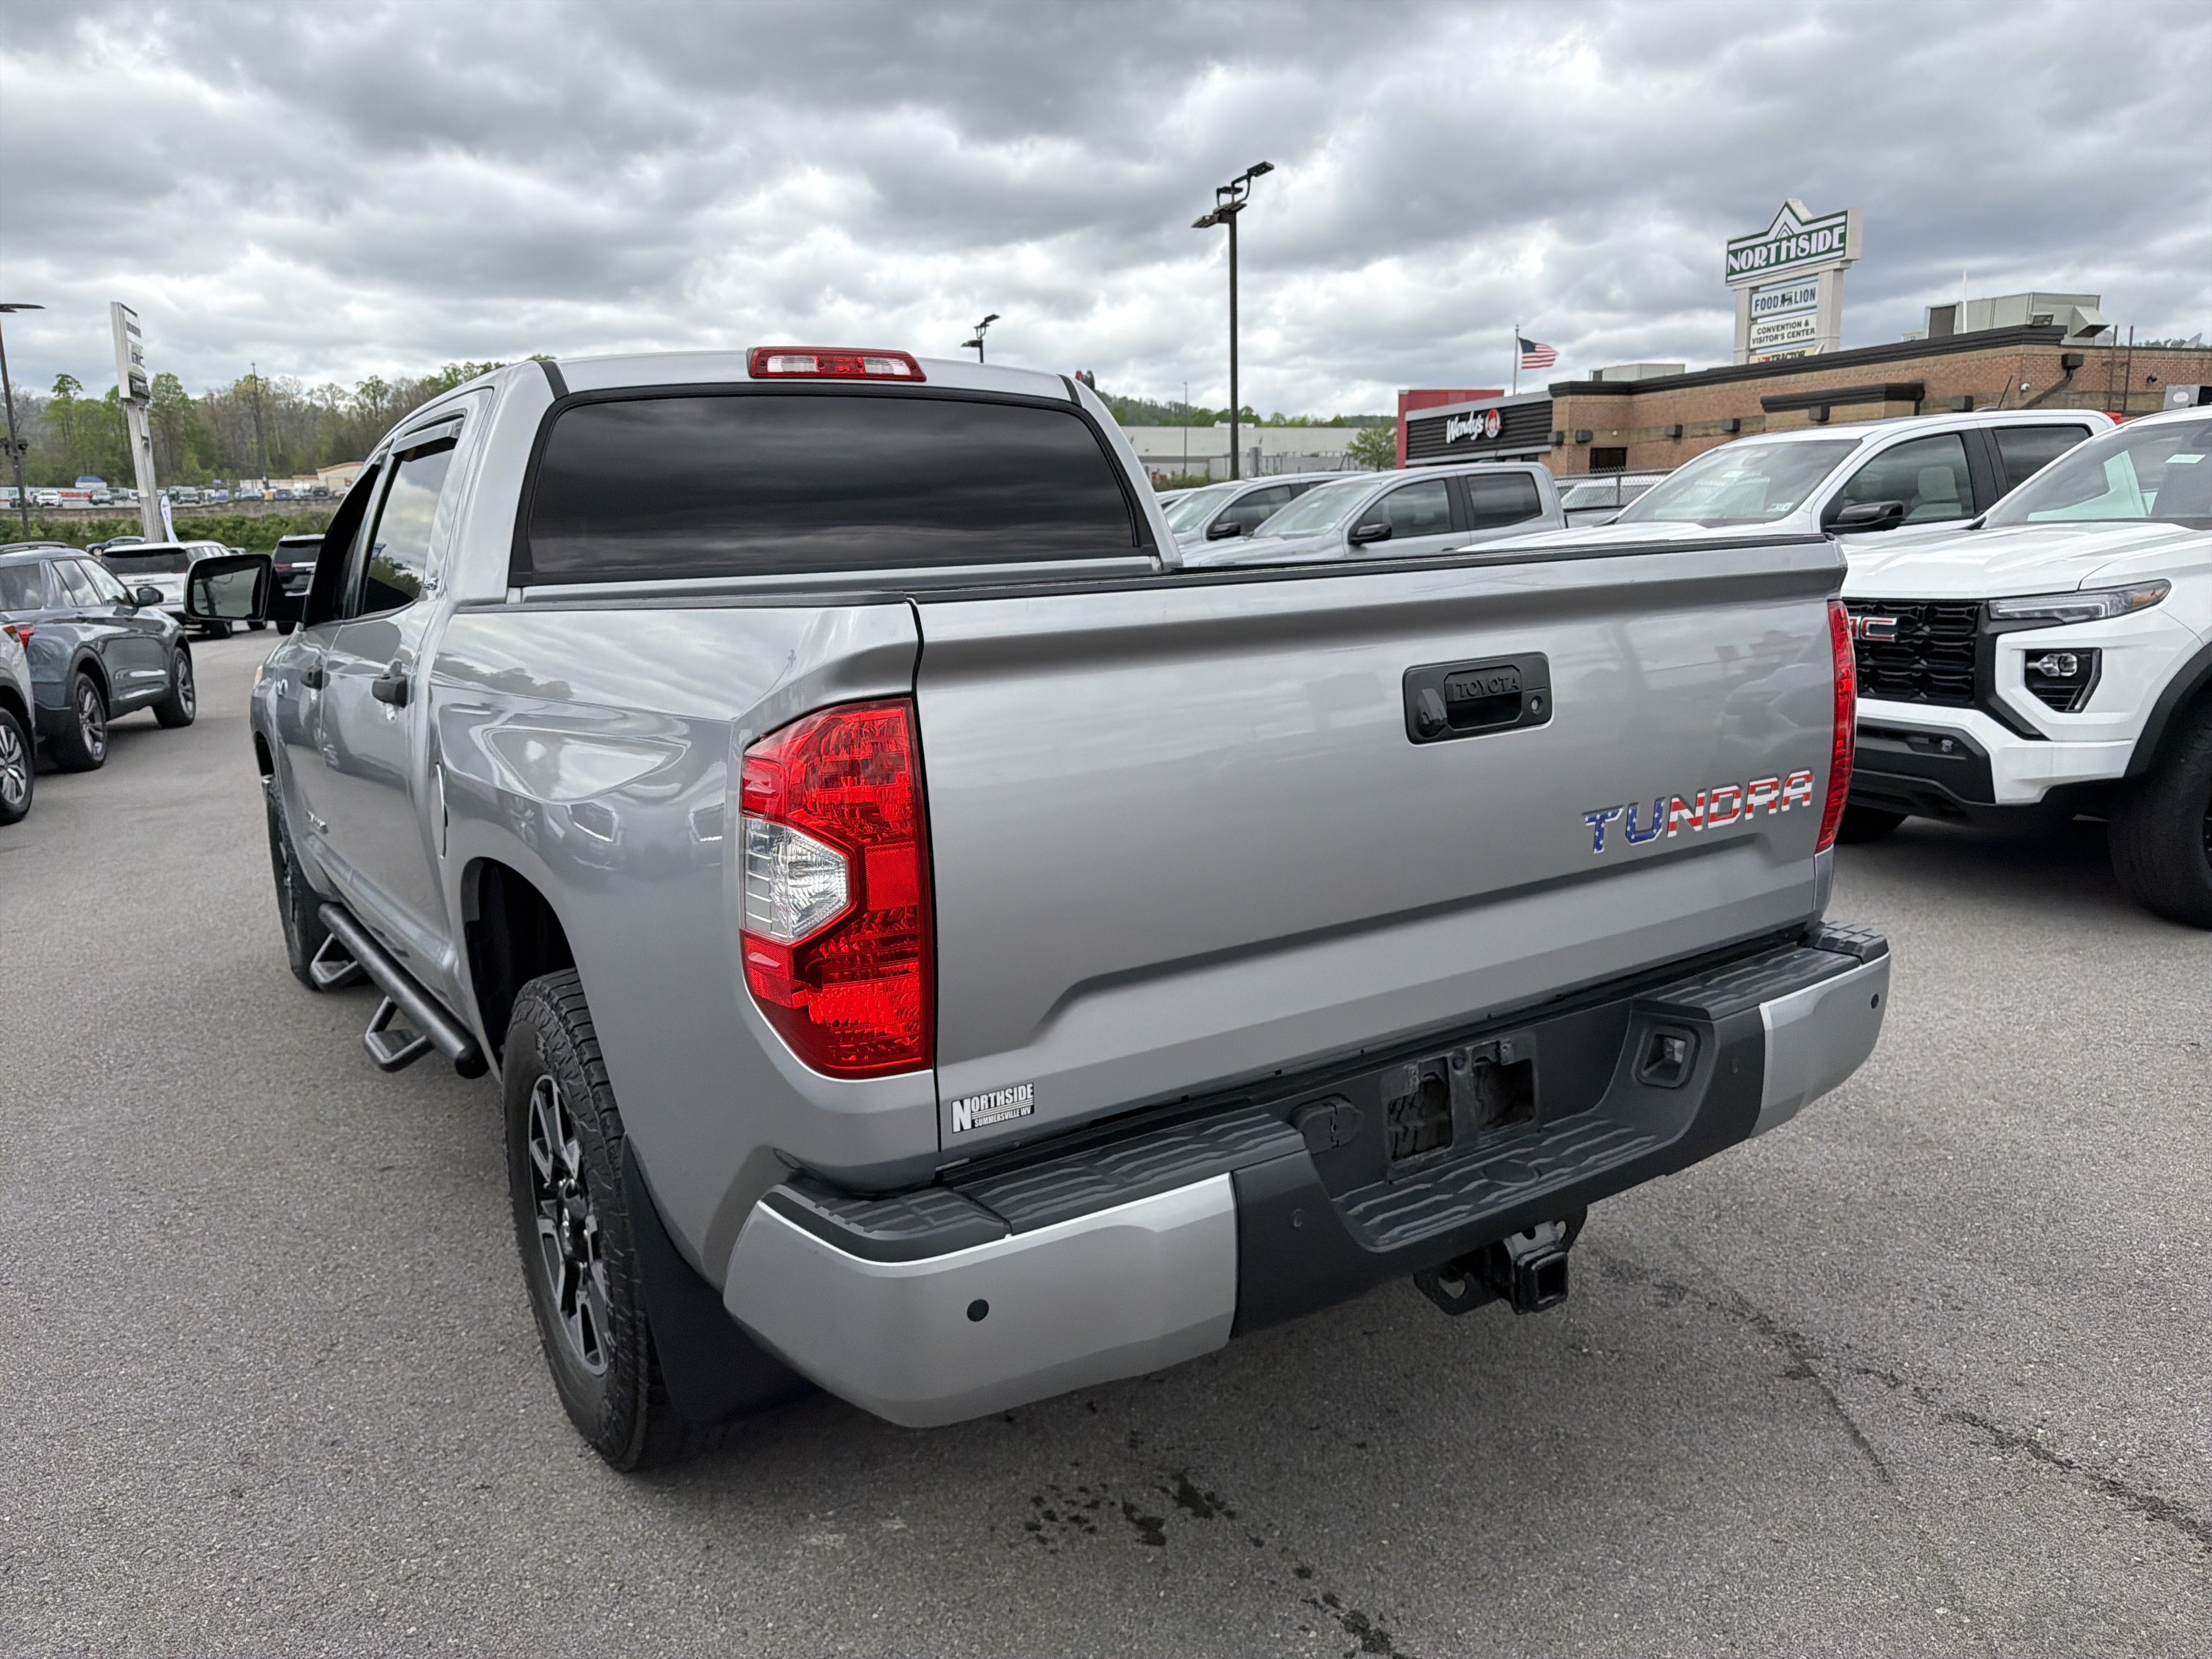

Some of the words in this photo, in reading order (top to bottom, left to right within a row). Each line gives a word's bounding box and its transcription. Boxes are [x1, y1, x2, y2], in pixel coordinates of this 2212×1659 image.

[1728, 225, 1846, 273] NORTHSIDE
[1754, 295, 1779, 312] FOOD
[1794, 287, 1816, 304] LION
[1752, 332, 1785, 345] VISITOR'S
[1787, 328, 1815, 339] CENTER
[1757, 320, 1802, 335] CONVENTION
[1804, 319, 1809, 328] &
[1446, 411, 1483, 444] Wendy's
[1455, 677, 1520, 698] TOYOTA
[1583, 769, 1813, 854] TUNDRA
[952, 1083, 1034, 1133] NORTHSIDE
[974, 1109, 1020, 1127] SUMMERSVILLE
[1020, 1106, 1031, 1117] WV
